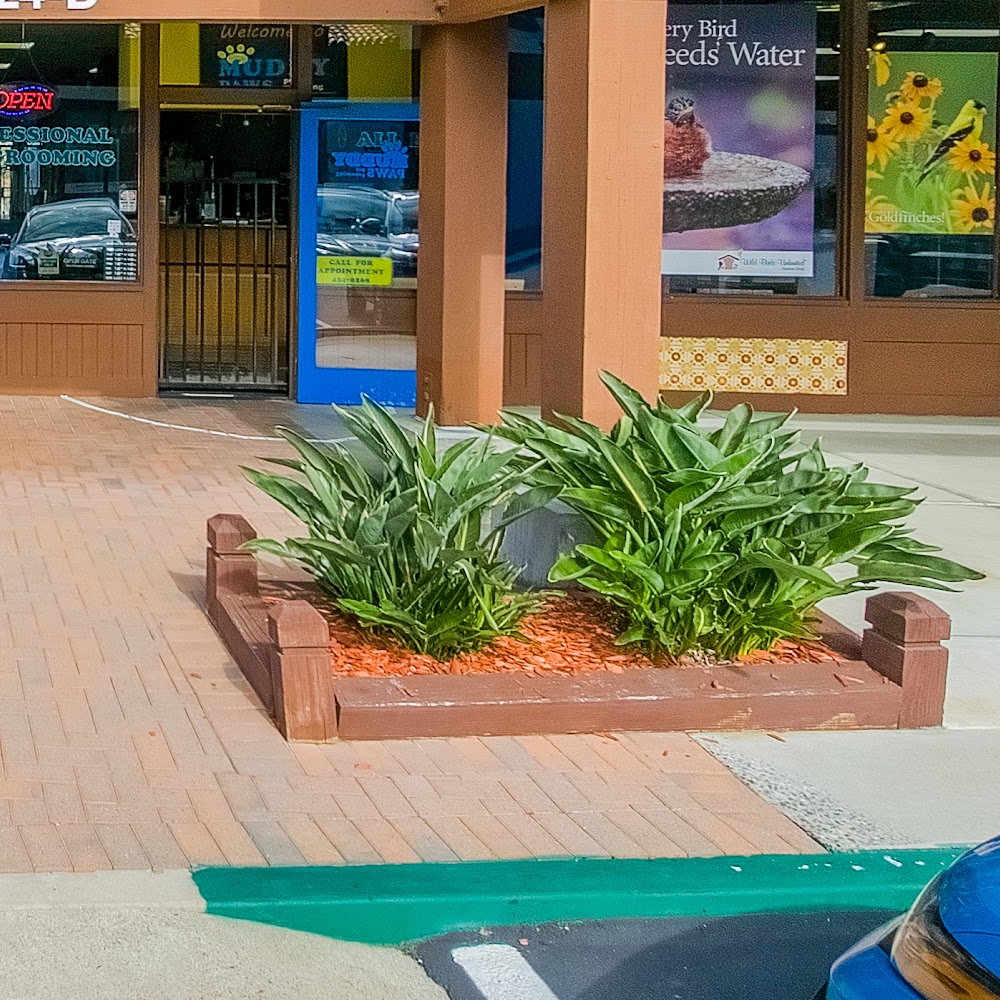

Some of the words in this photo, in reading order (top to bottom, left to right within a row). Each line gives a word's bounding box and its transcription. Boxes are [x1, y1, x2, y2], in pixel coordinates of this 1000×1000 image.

[220, 24, 293, 38] Welcome
[698, 19, 738, 38] Bird
[726, 41, 806, 66] Water
[868, 210, 945, 223] Goldfinches!
[318, 267, 385, 275] APPOINTMENT
